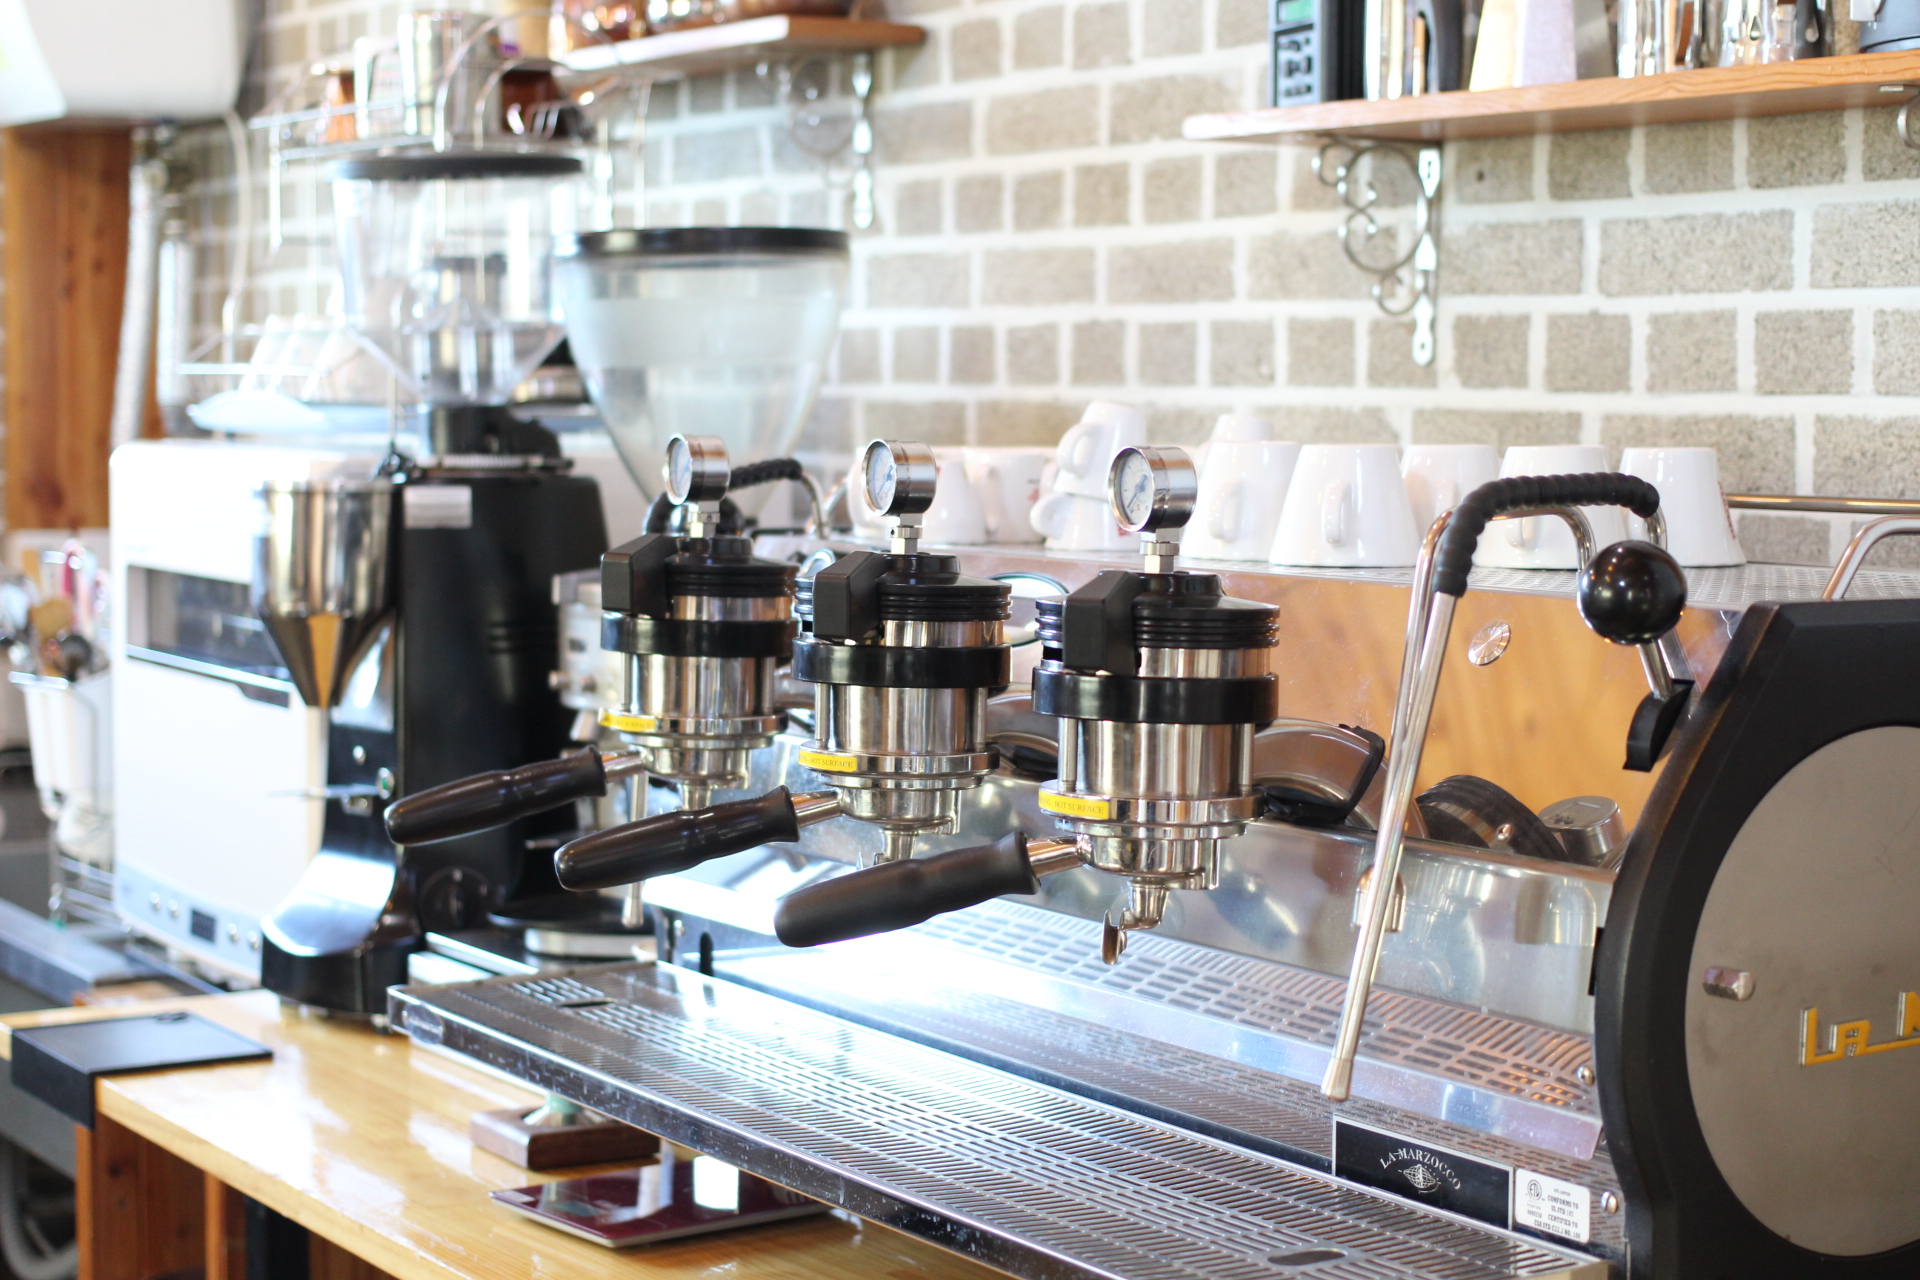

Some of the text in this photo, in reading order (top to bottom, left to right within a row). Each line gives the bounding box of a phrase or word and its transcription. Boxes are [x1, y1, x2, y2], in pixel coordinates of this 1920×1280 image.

[811, 757, 821, 765] HOT
[821, 759, 854, 769] SURFACE
[1054, 801, 1067, 809] HOT
[1067, 802, 1105, 814] SURFACE
[1799, 1007, 1871, 1067] LA
[1379, 1147, 1462, 1191] LA MARZOCCO
[1547, 1194, 1572, 1208] CONFORMS
[1572, 1202, 1579, 1210] TO
[1551, 1205, 1557, 1213] UL
[1557, 1206, 1566, 1215] STD
[1533, 1219, 1543, 1227] CSA
[1543, 1222, 1552, 1231] STD
[1547, 1213, 1579, 1229] CERTIFIED TO
